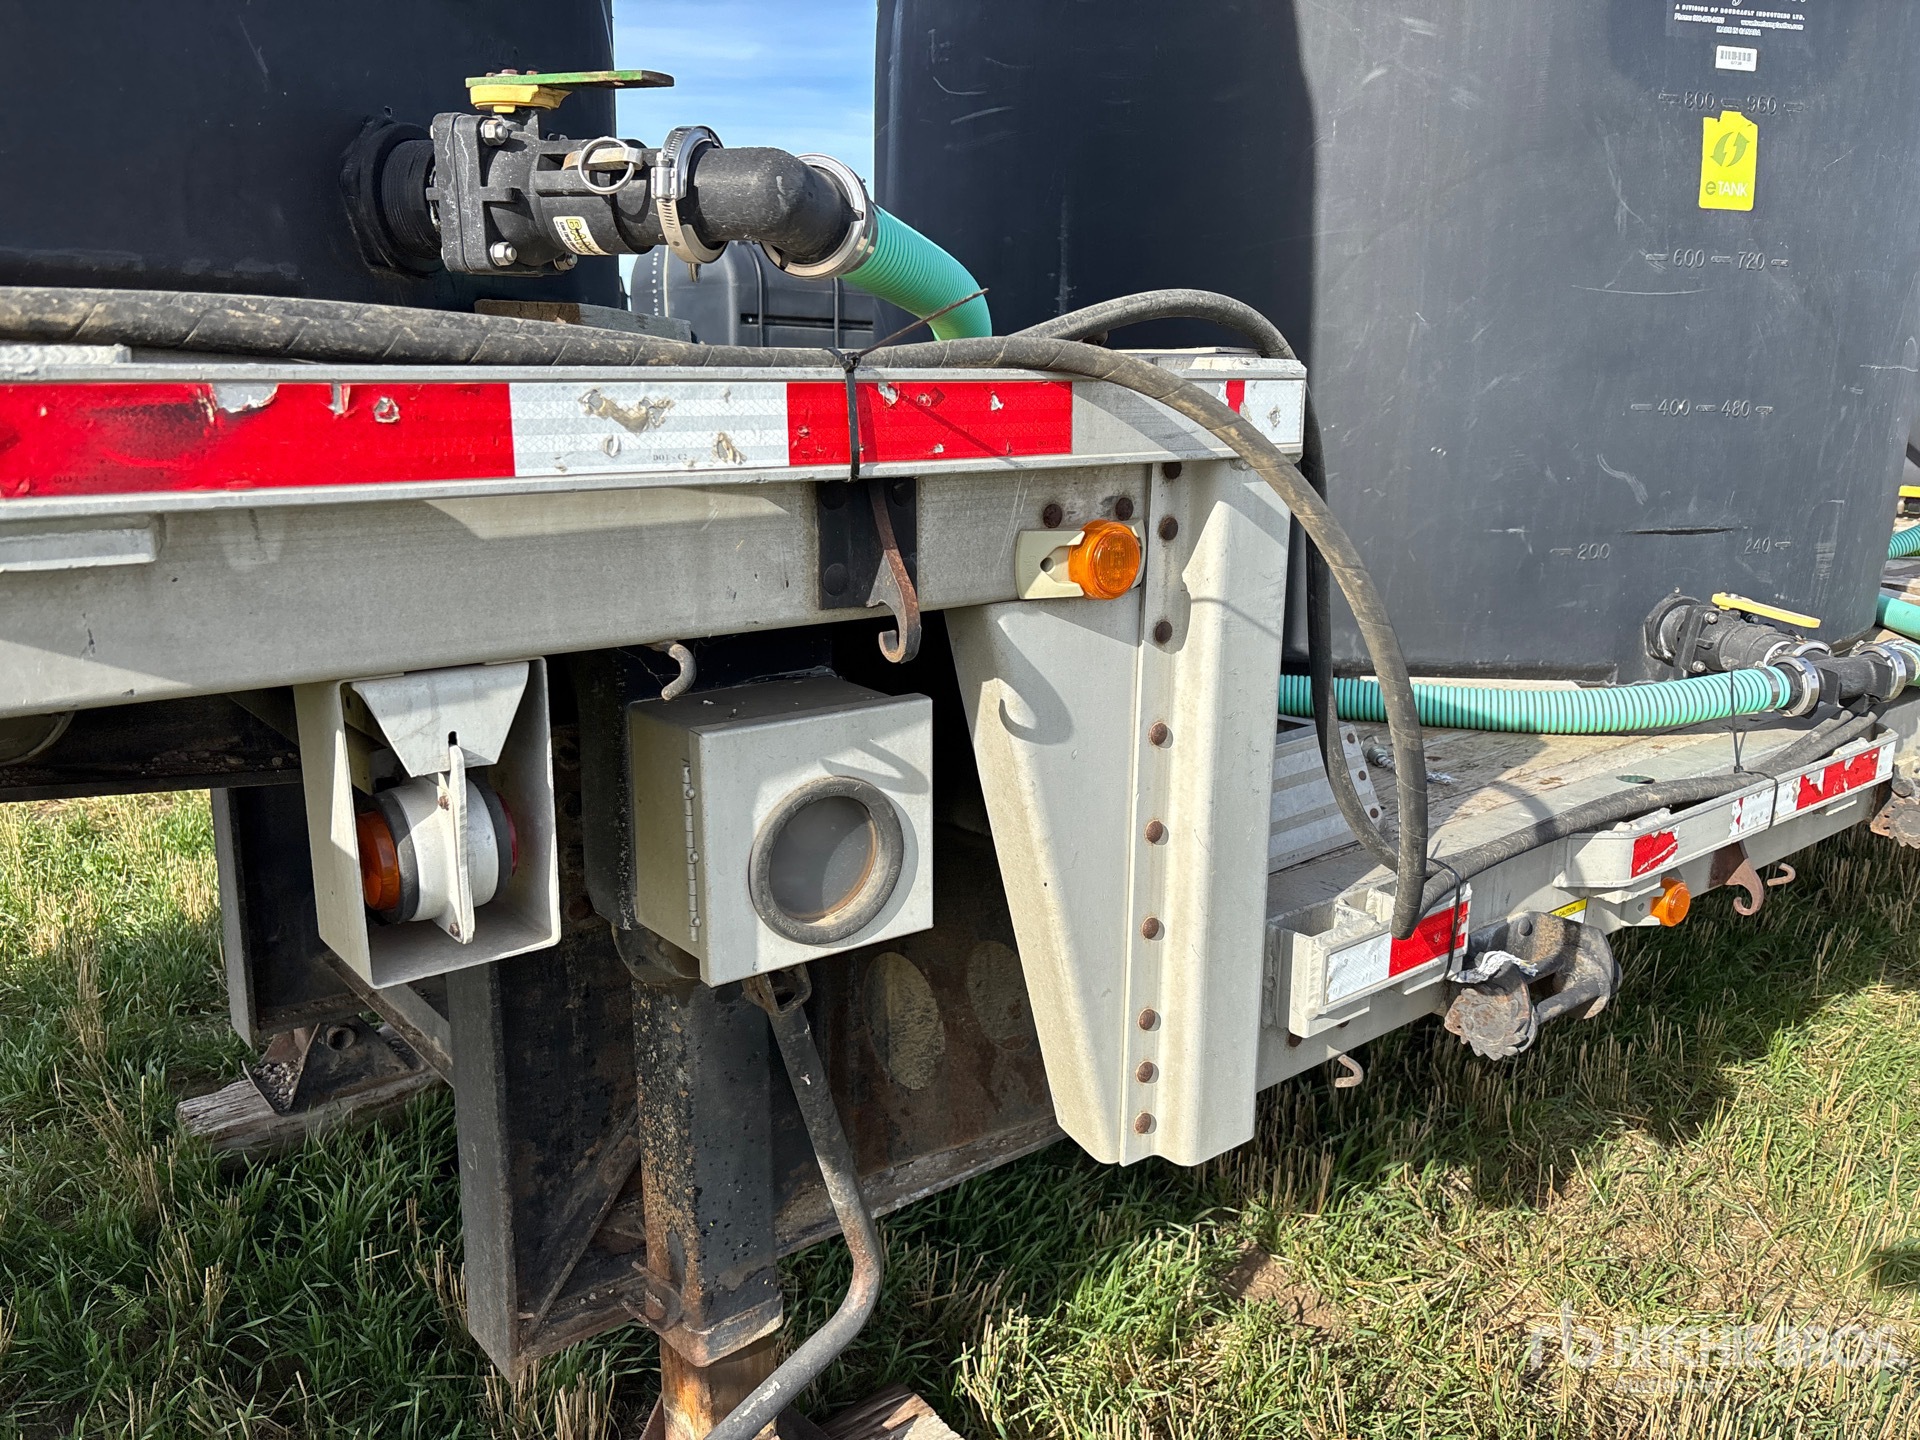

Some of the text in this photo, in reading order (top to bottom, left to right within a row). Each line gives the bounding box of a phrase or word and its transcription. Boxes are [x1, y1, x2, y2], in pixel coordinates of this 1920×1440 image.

[1684, 91, 1777, 114] 800 960
[1672, 248, 1766, 271] 600 720
[1657, 399, 1751, 418] 400 480
[1576, 537, 1771, 561] 200 240
